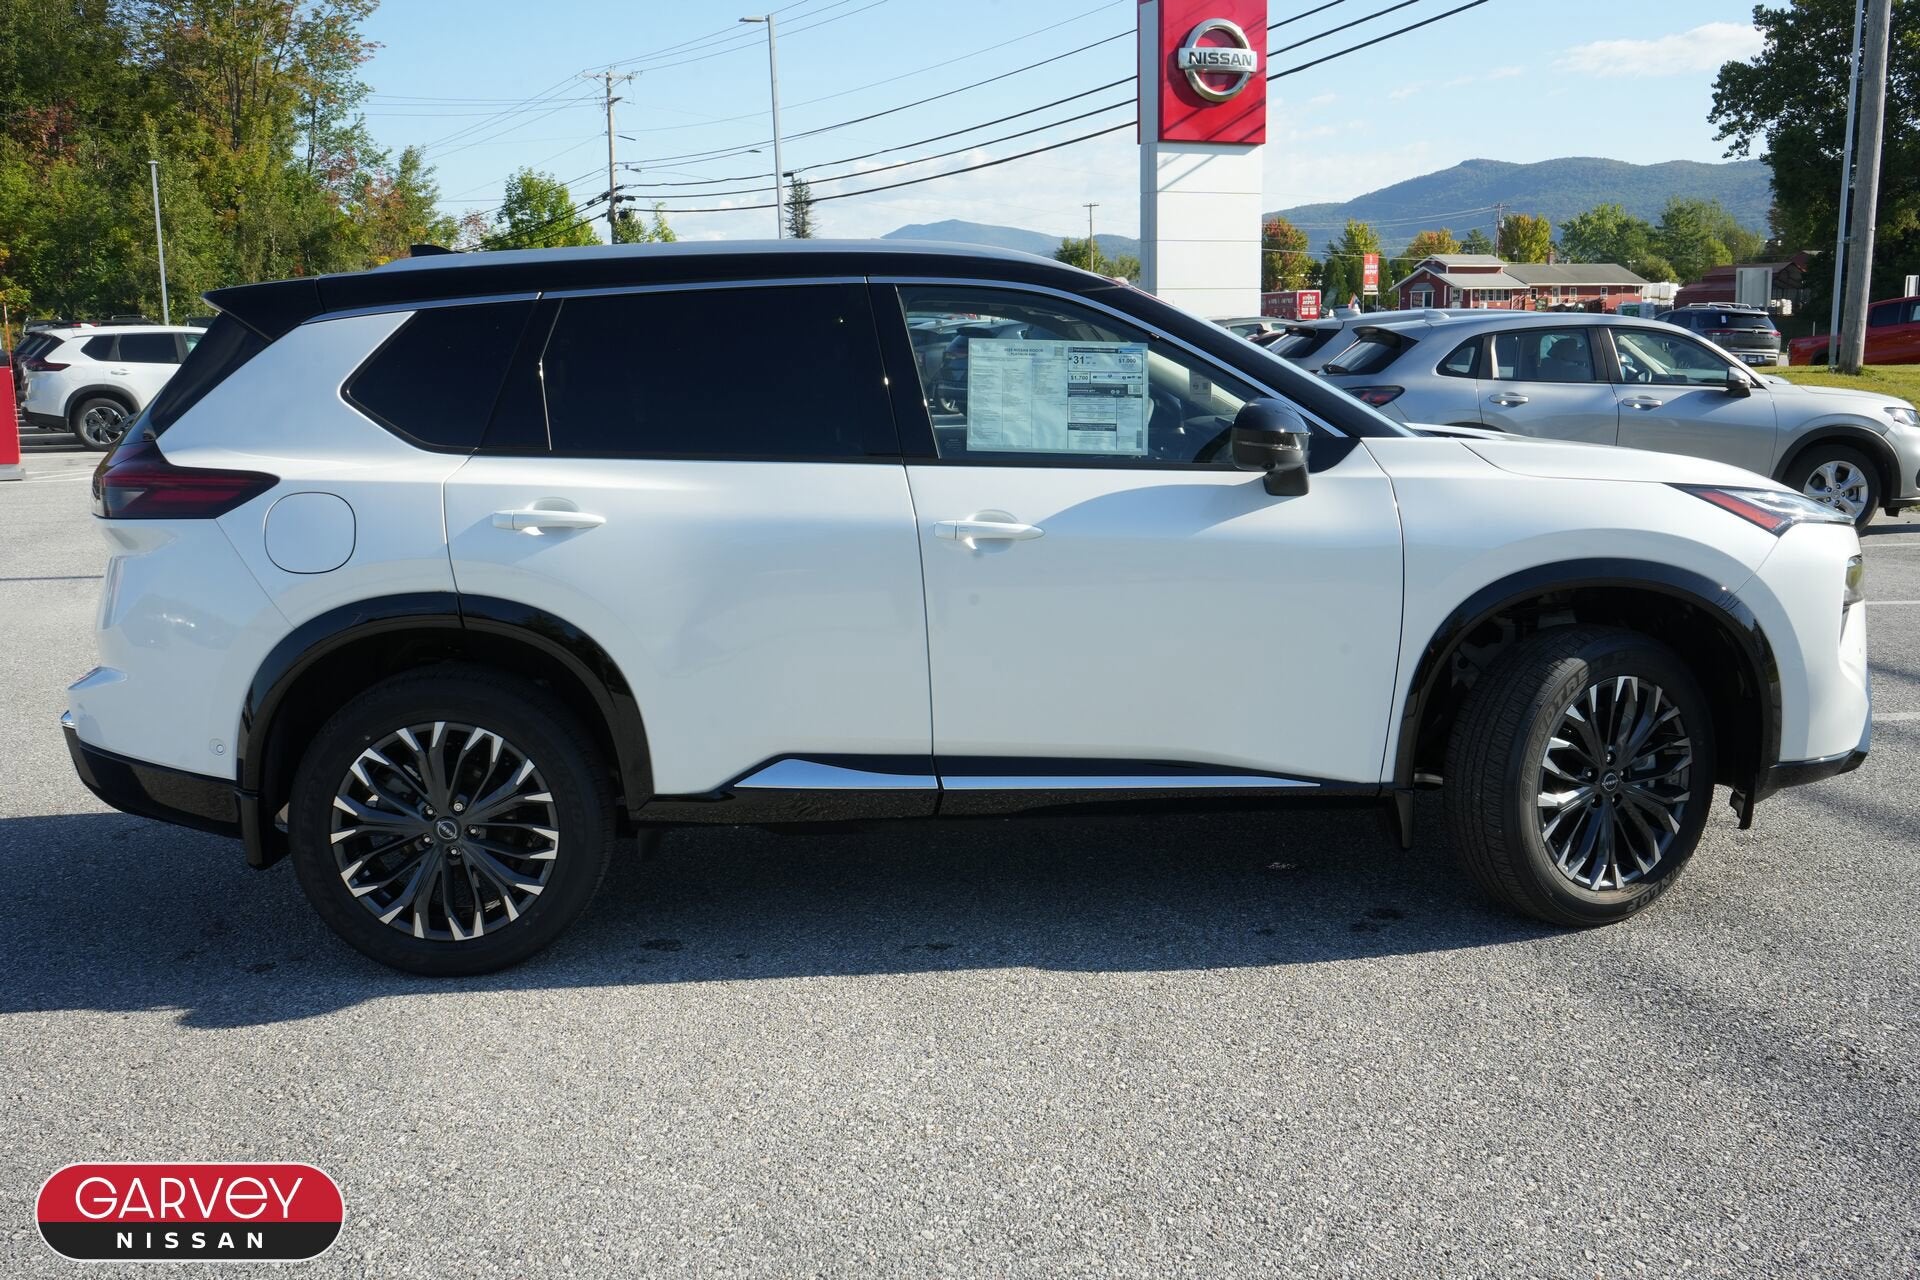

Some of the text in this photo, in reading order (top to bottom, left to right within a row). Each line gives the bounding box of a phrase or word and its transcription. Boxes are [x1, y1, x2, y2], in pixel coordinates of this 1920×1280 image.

[1188, 51, 1252, 67] NISSAN
[1073, 355, 1084, 365] 31
[1521, 661, 1600, 802] GRANDTRE
